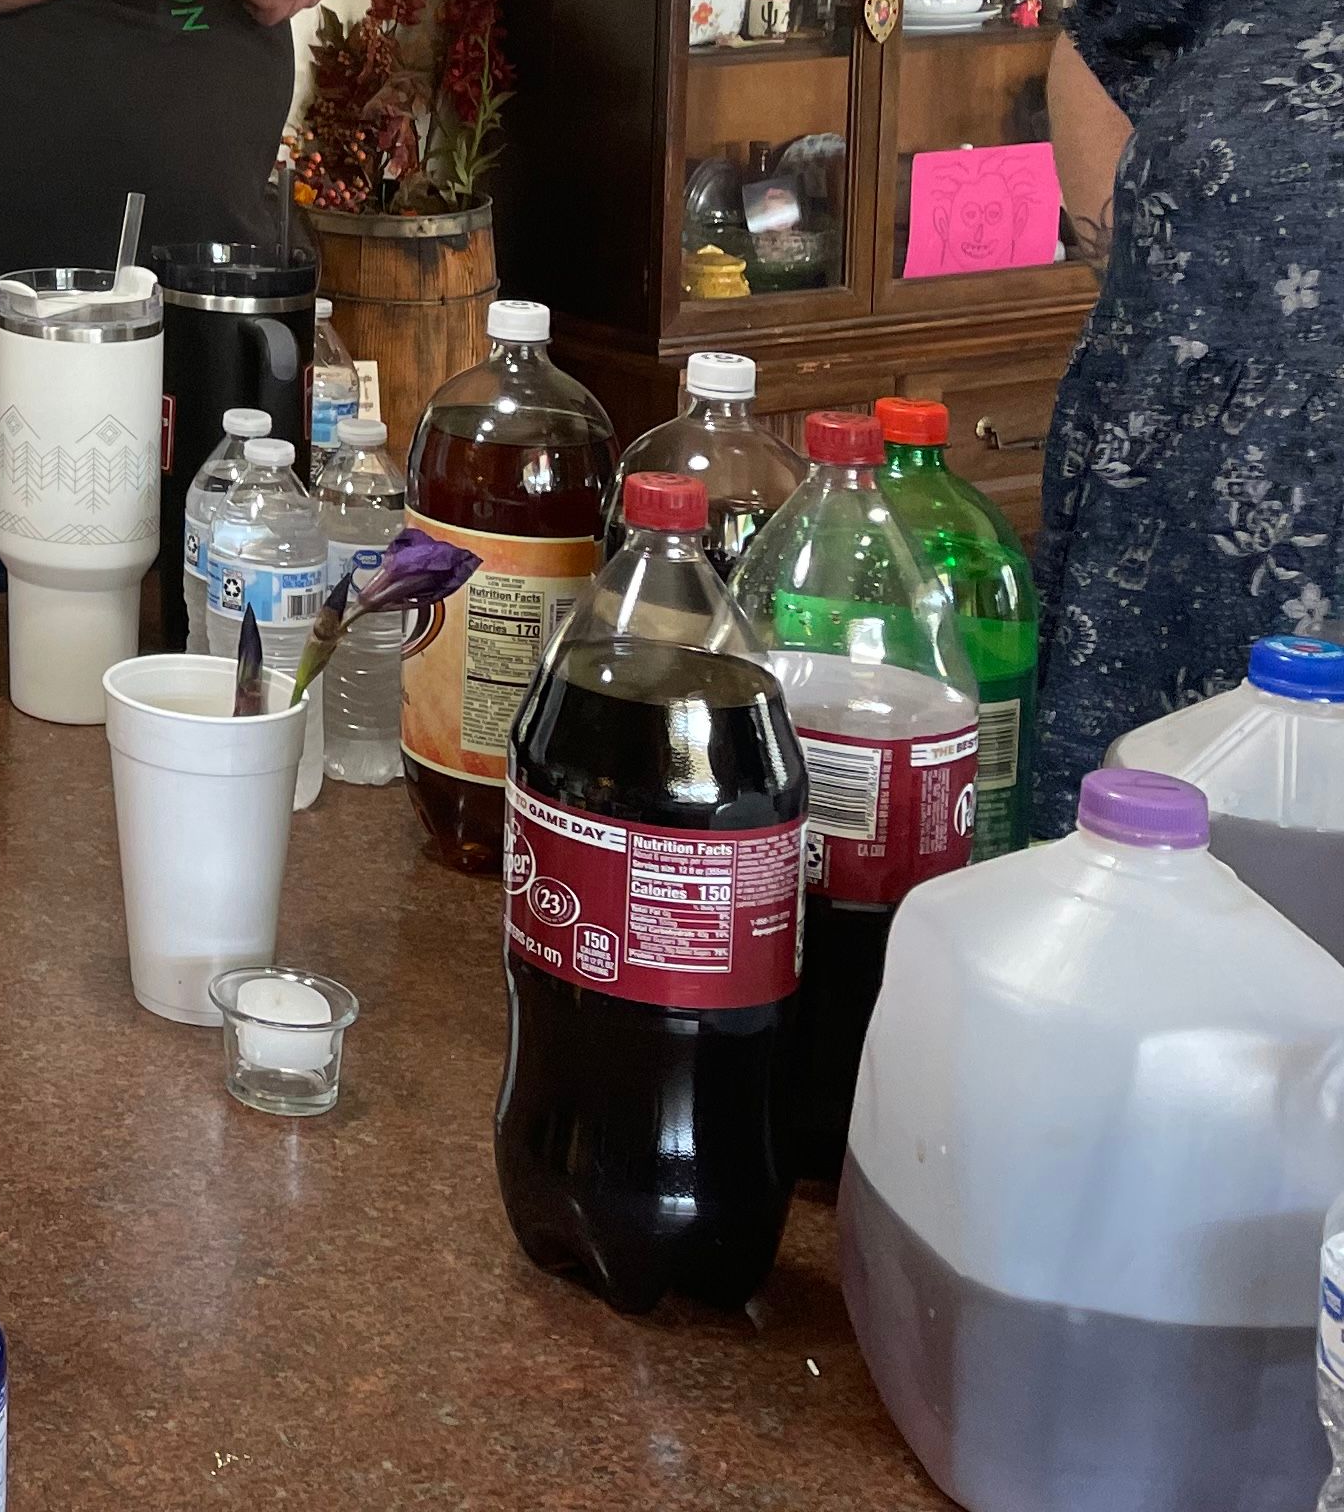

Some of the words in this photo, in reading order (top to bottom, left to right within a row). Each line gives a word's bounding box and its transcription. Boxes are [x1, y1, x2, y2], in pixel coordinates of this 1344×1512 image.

[469, 585, 512, 601] Nutrition
[514, 592, 541, 603] Facts
[468, 619, 507, 634] Calories
[515, 623, 541, 637] 170
[930, 746, 955, 759] THE
[514, 792, 528, 810] TO
[528, 802, 568, 830] GAME
[570, 821, 607, 842] DAY
[633, 835, 695, 855] Nutrition
[697, 843, 733, 856] Facts
[632, 859, 659, 872] Serving
[539, 888, 561, 915] 23
[631, 881, 688, 901] Calories
[698, 885, 731, 902] 150
[583, 930, 610, 951] 150
